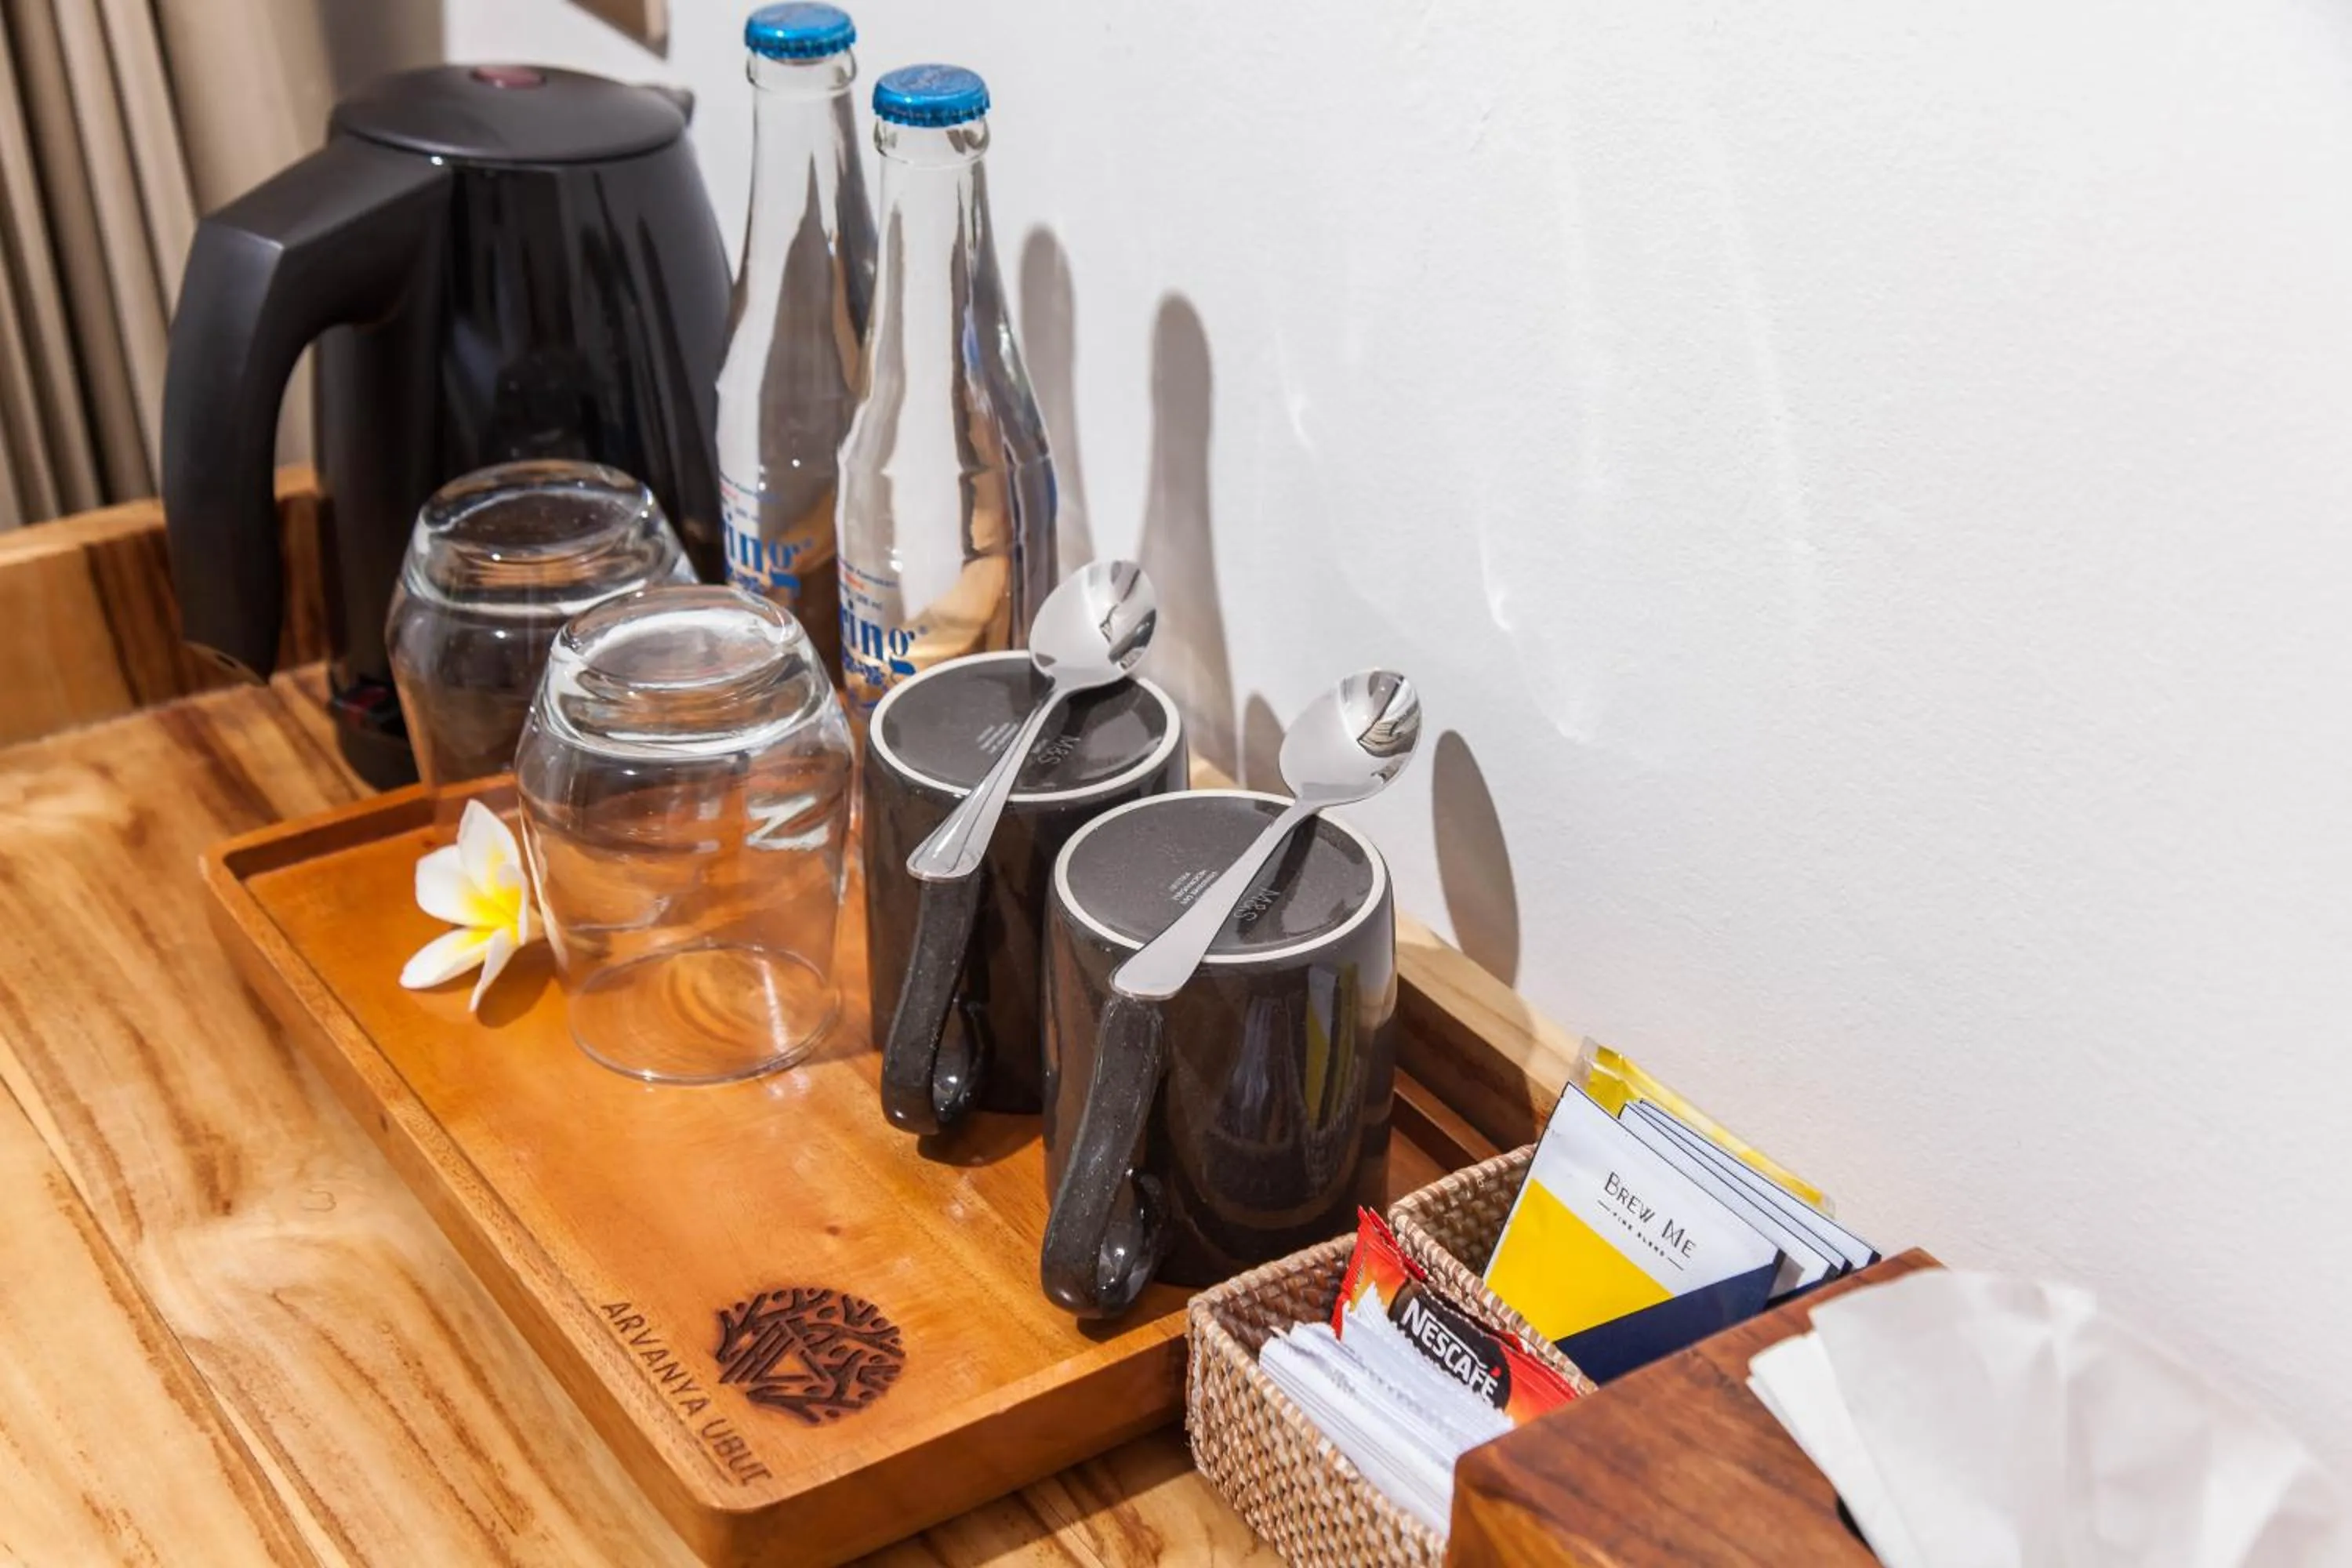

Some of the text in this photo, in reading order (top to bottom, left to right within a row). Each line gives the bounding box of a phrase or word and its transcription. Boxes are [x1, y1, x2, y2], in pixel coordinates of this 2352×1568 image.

[720, 511, 800, 599] ing
[840, 599, 916, 676] ing
[601, 1301, 710, 1417] ARVANYA
